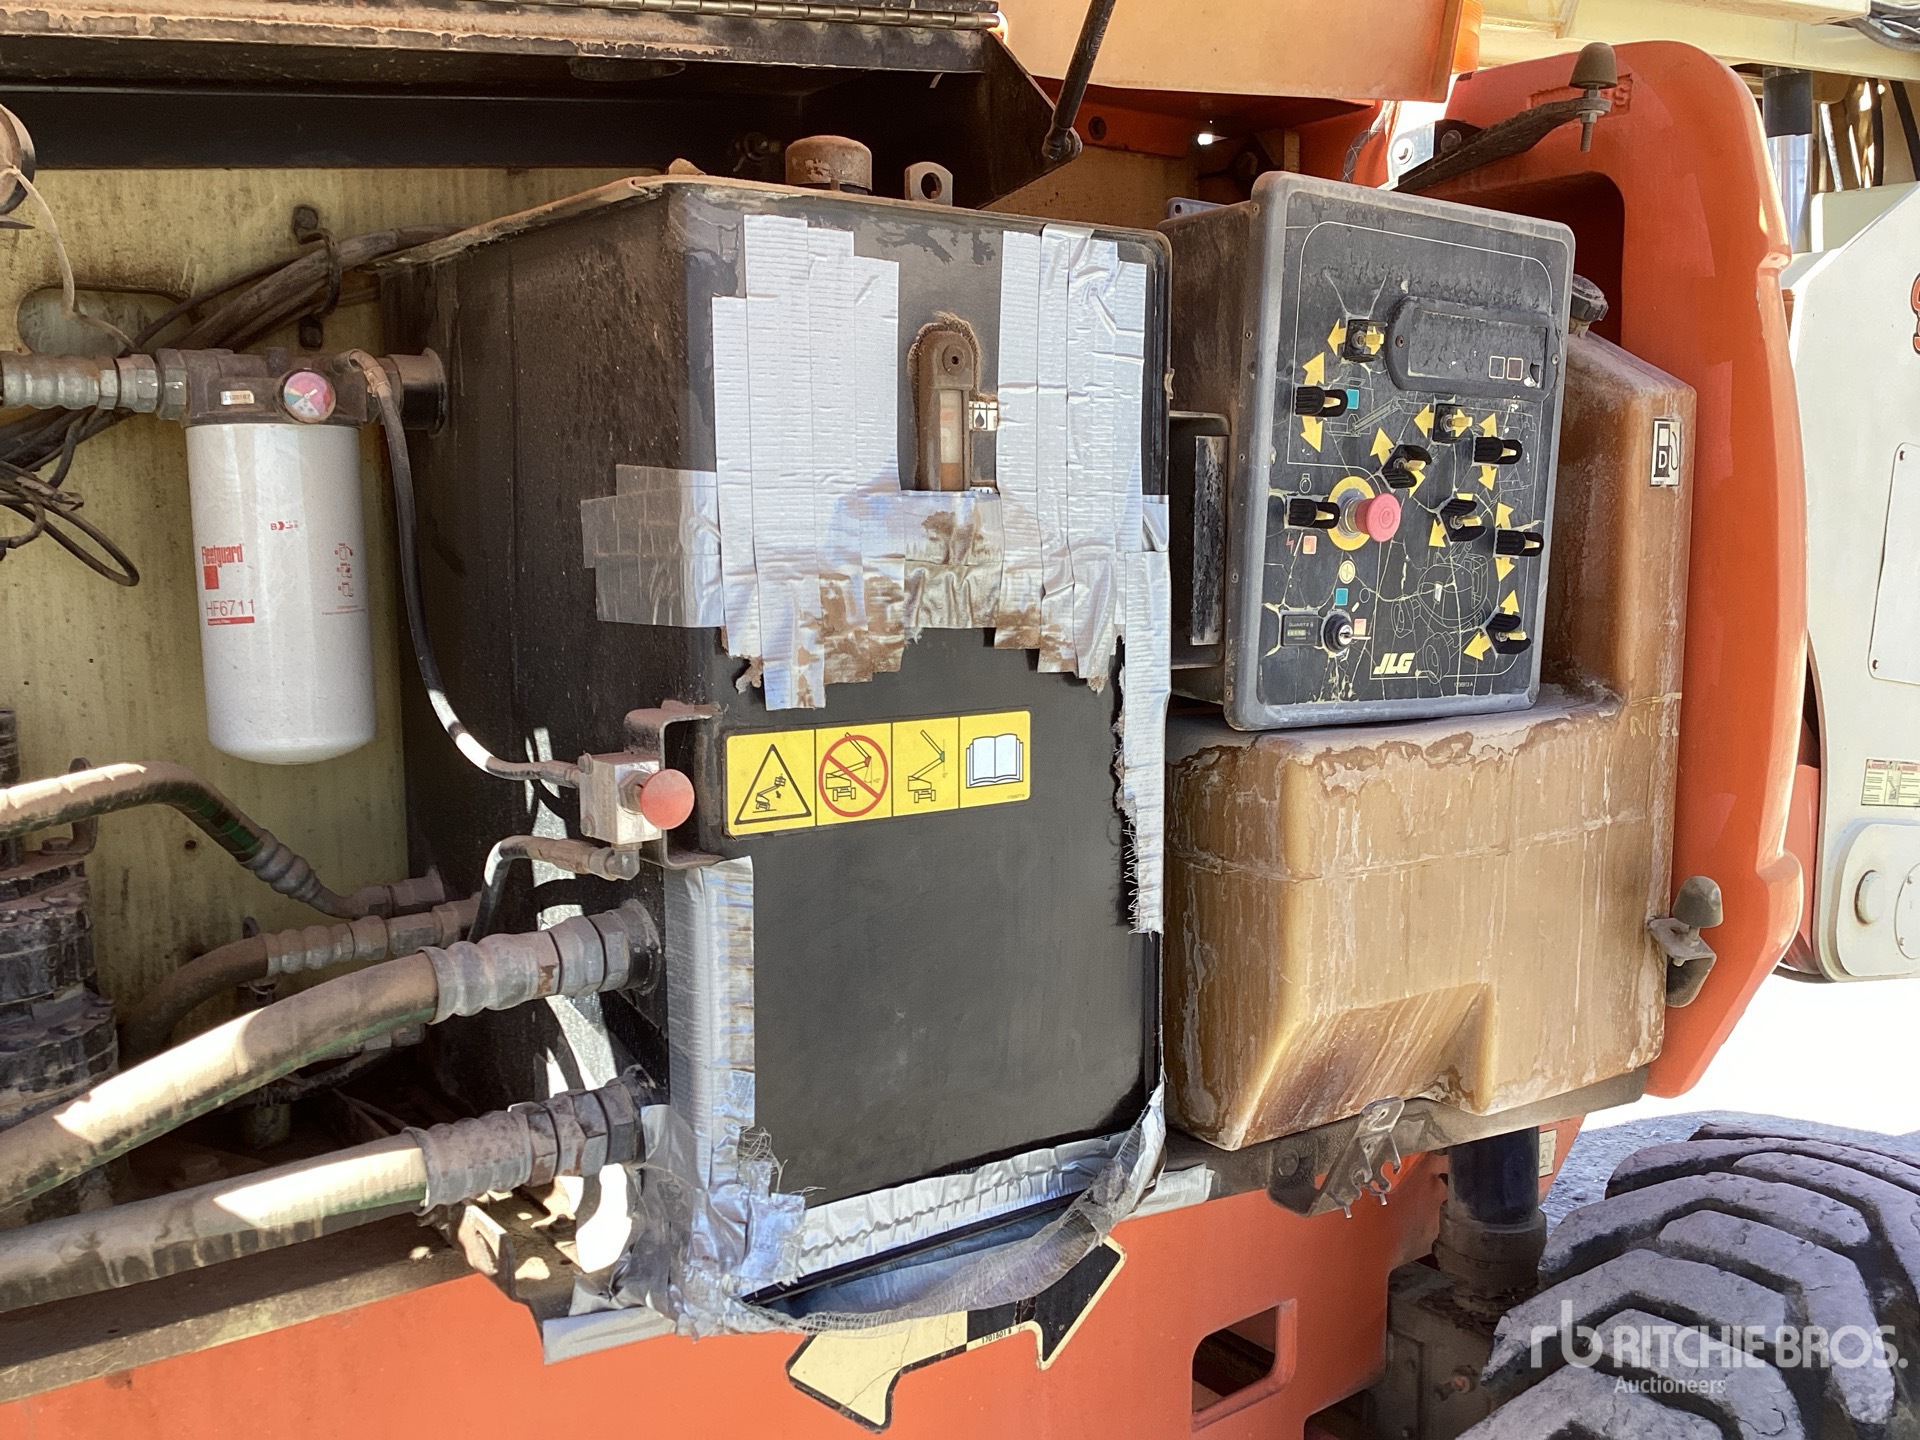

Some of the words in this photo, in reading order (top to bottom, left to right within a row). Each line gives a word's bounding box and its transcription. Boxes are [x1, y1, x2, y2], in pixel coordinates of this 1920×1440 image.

[1658, 450, 1668, 469] D
[201, 543, 243, 567] Fleetguard
[205, 599, 255, 616] HF6711
[1373, 652, 1416, 675] JLG
